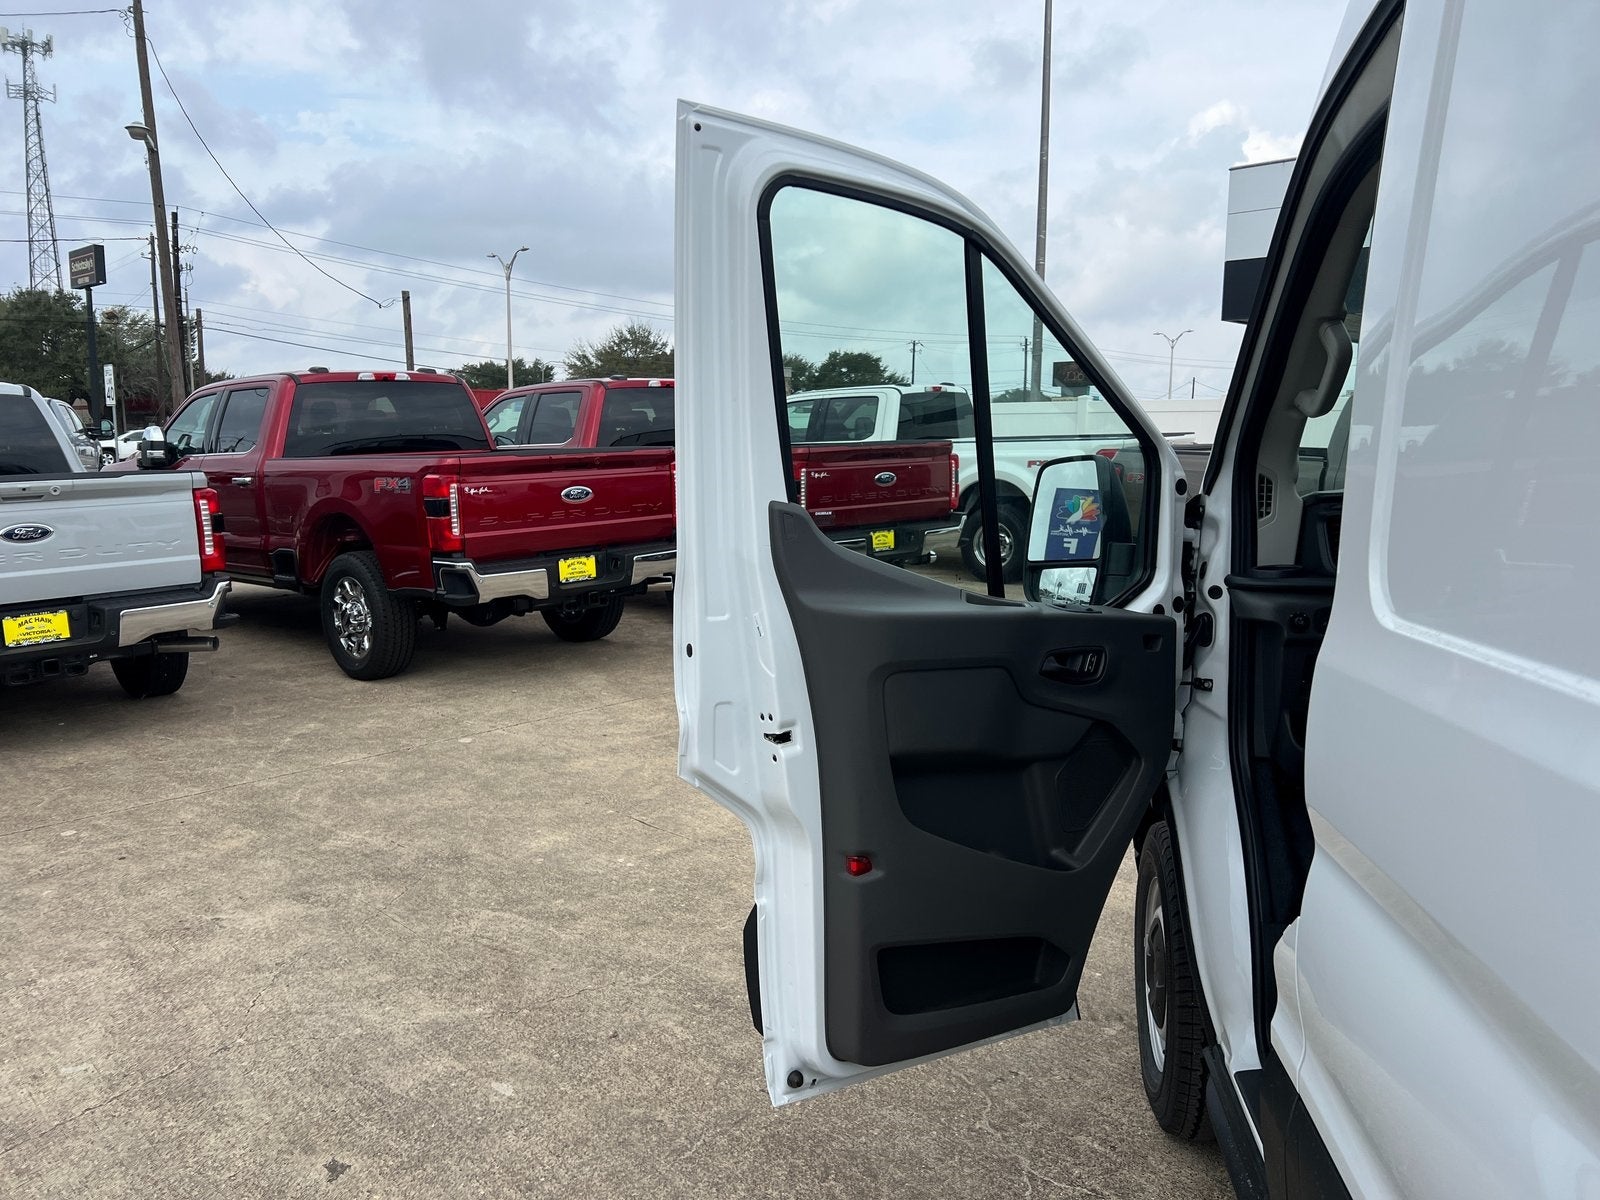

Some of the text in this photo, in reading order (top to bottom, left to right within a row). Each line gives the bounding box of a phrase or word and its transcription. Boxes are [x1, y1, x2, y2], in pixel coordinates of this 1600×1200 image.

[374, 477, 411, 494] FX4
[479, 501, 663, 526] SUPER DUTY
[17, 616, 53, 628] MAC HAIK
[21, 629, 51, 637] VICTORIA
